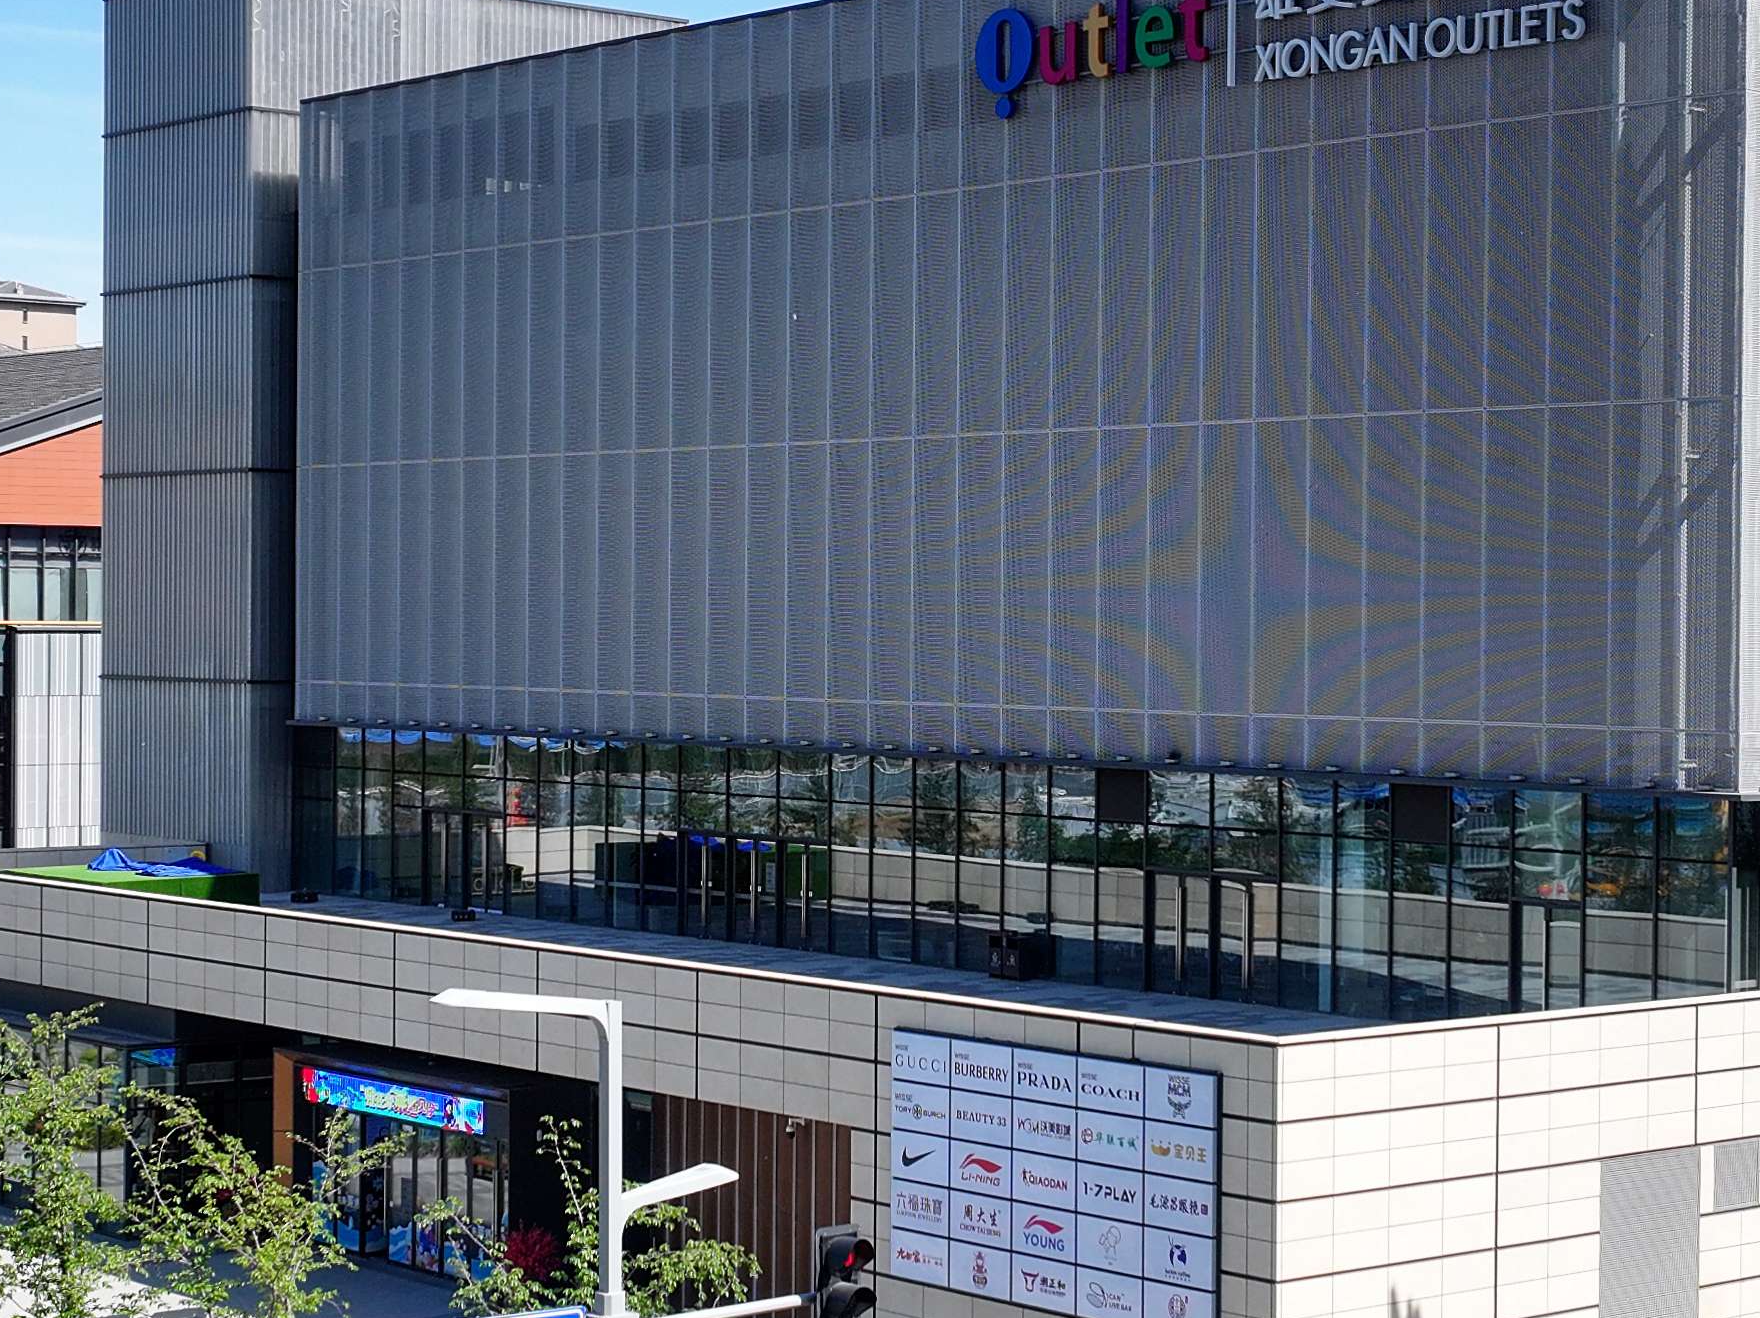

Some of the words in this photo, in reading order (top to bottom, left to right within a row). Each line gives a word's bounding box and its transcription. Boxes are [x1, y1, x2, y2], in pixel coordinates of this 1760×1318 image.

[1254, 22, 1419, 83] XIONGAN
[895, 1053, 947, 1073] GUCCI
[954, 1062, 1009, 1083] BURBERRY
[1017, 1071, 1072, 1093] PRADA
[1080, 1083, 1140, 1102] COACH
[956, 1109, 995, 1125] BEAUTY
[996, 1116, 1007, 1128] 33
[961, 1171, 1001, 1187] LI-NING
[963, 1203, 998, 1227] 周大生
[1023, 1232, 1065, 1252] YOUNG
